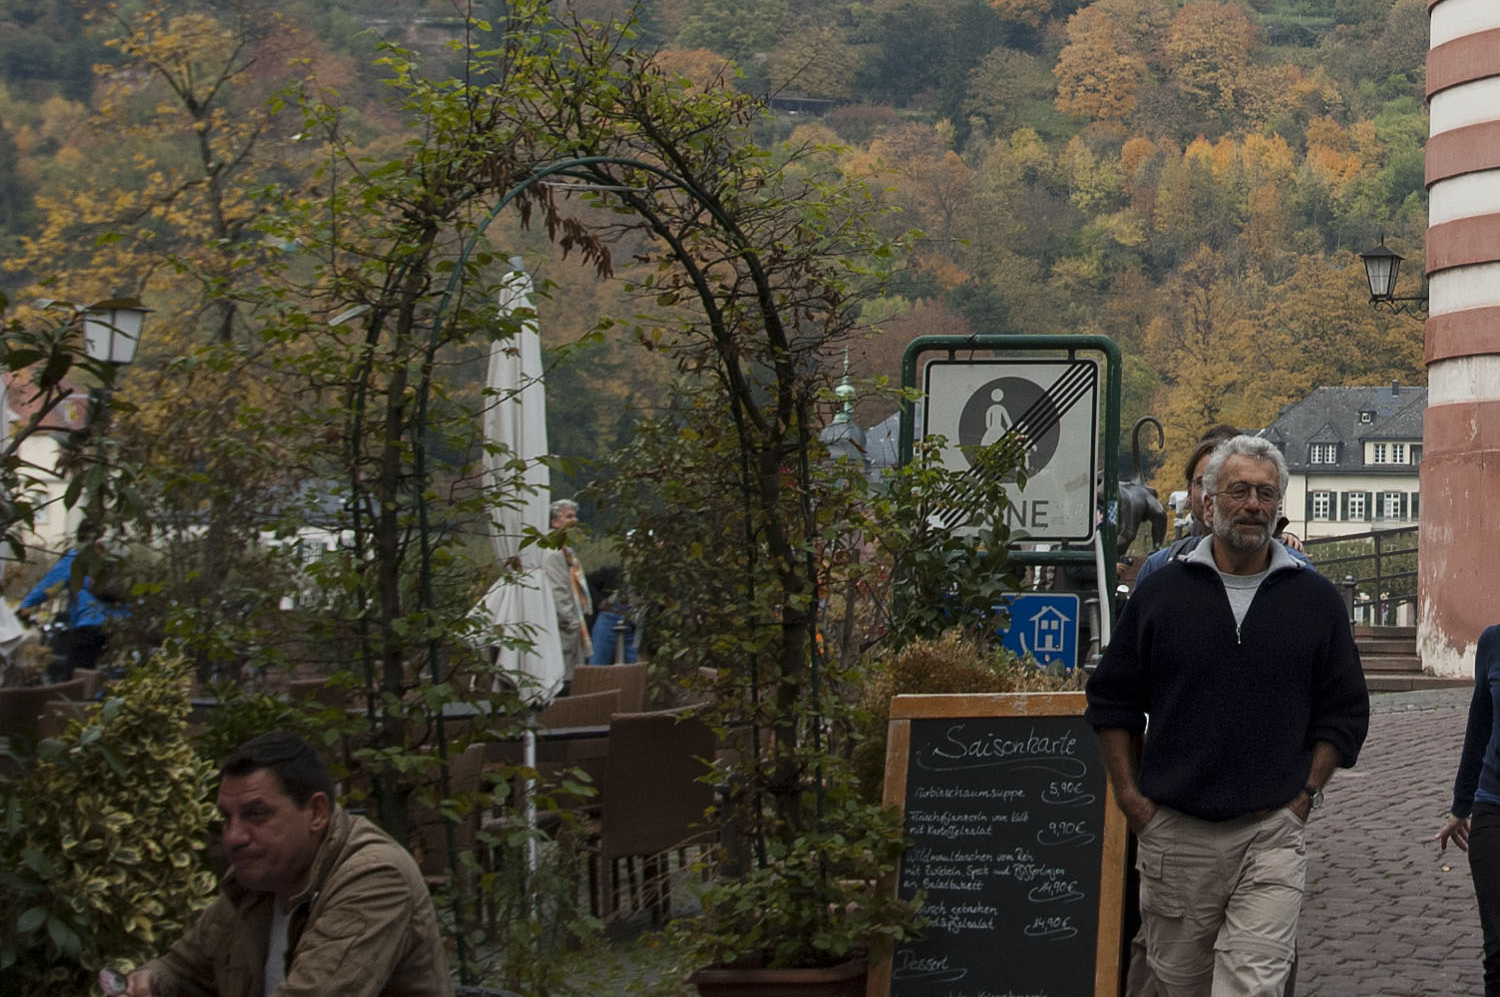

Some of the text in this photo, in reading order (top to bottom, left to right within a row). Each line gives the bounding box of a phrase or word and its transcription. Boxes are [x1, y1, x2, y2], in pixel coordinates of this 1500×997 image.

[930, 723, 1077, 760] Saisonkarte
[1049, 782, 1085, 798] 5,90€
[1048, 820, 1088, 838] 9,90€
